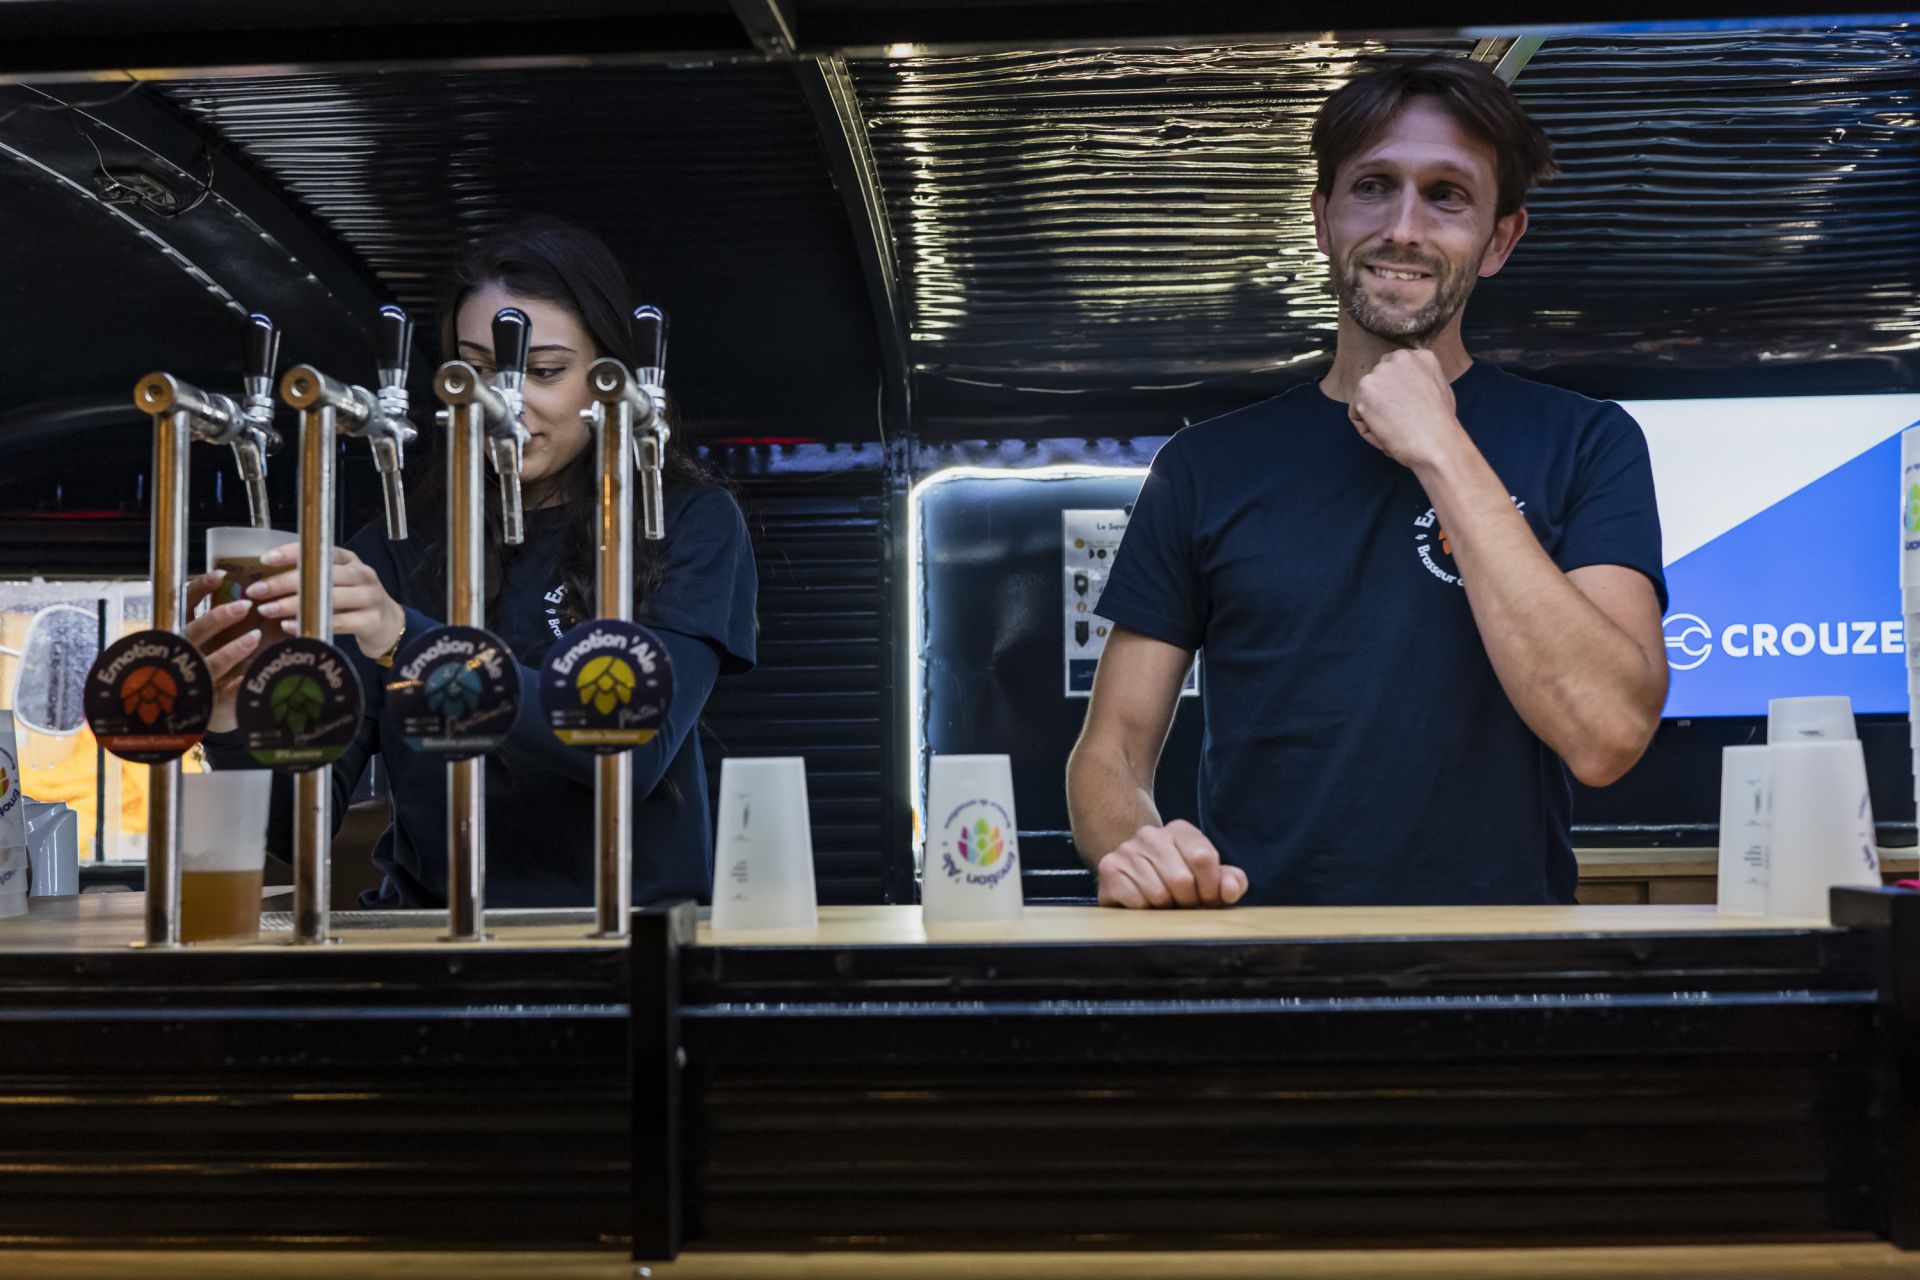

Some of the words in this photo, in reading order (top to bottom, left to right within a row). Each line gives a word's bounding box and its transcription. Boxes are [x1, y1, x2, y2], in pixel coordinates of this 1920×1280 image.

[1417, 544, 1457, 583] Brasseur
[97, 639, 169, 685] Emotion
[246, 647, 315, 695] Emotion
[400, 635, 475, 682] Emotion
[551, 629, 628, 675] Emotion
